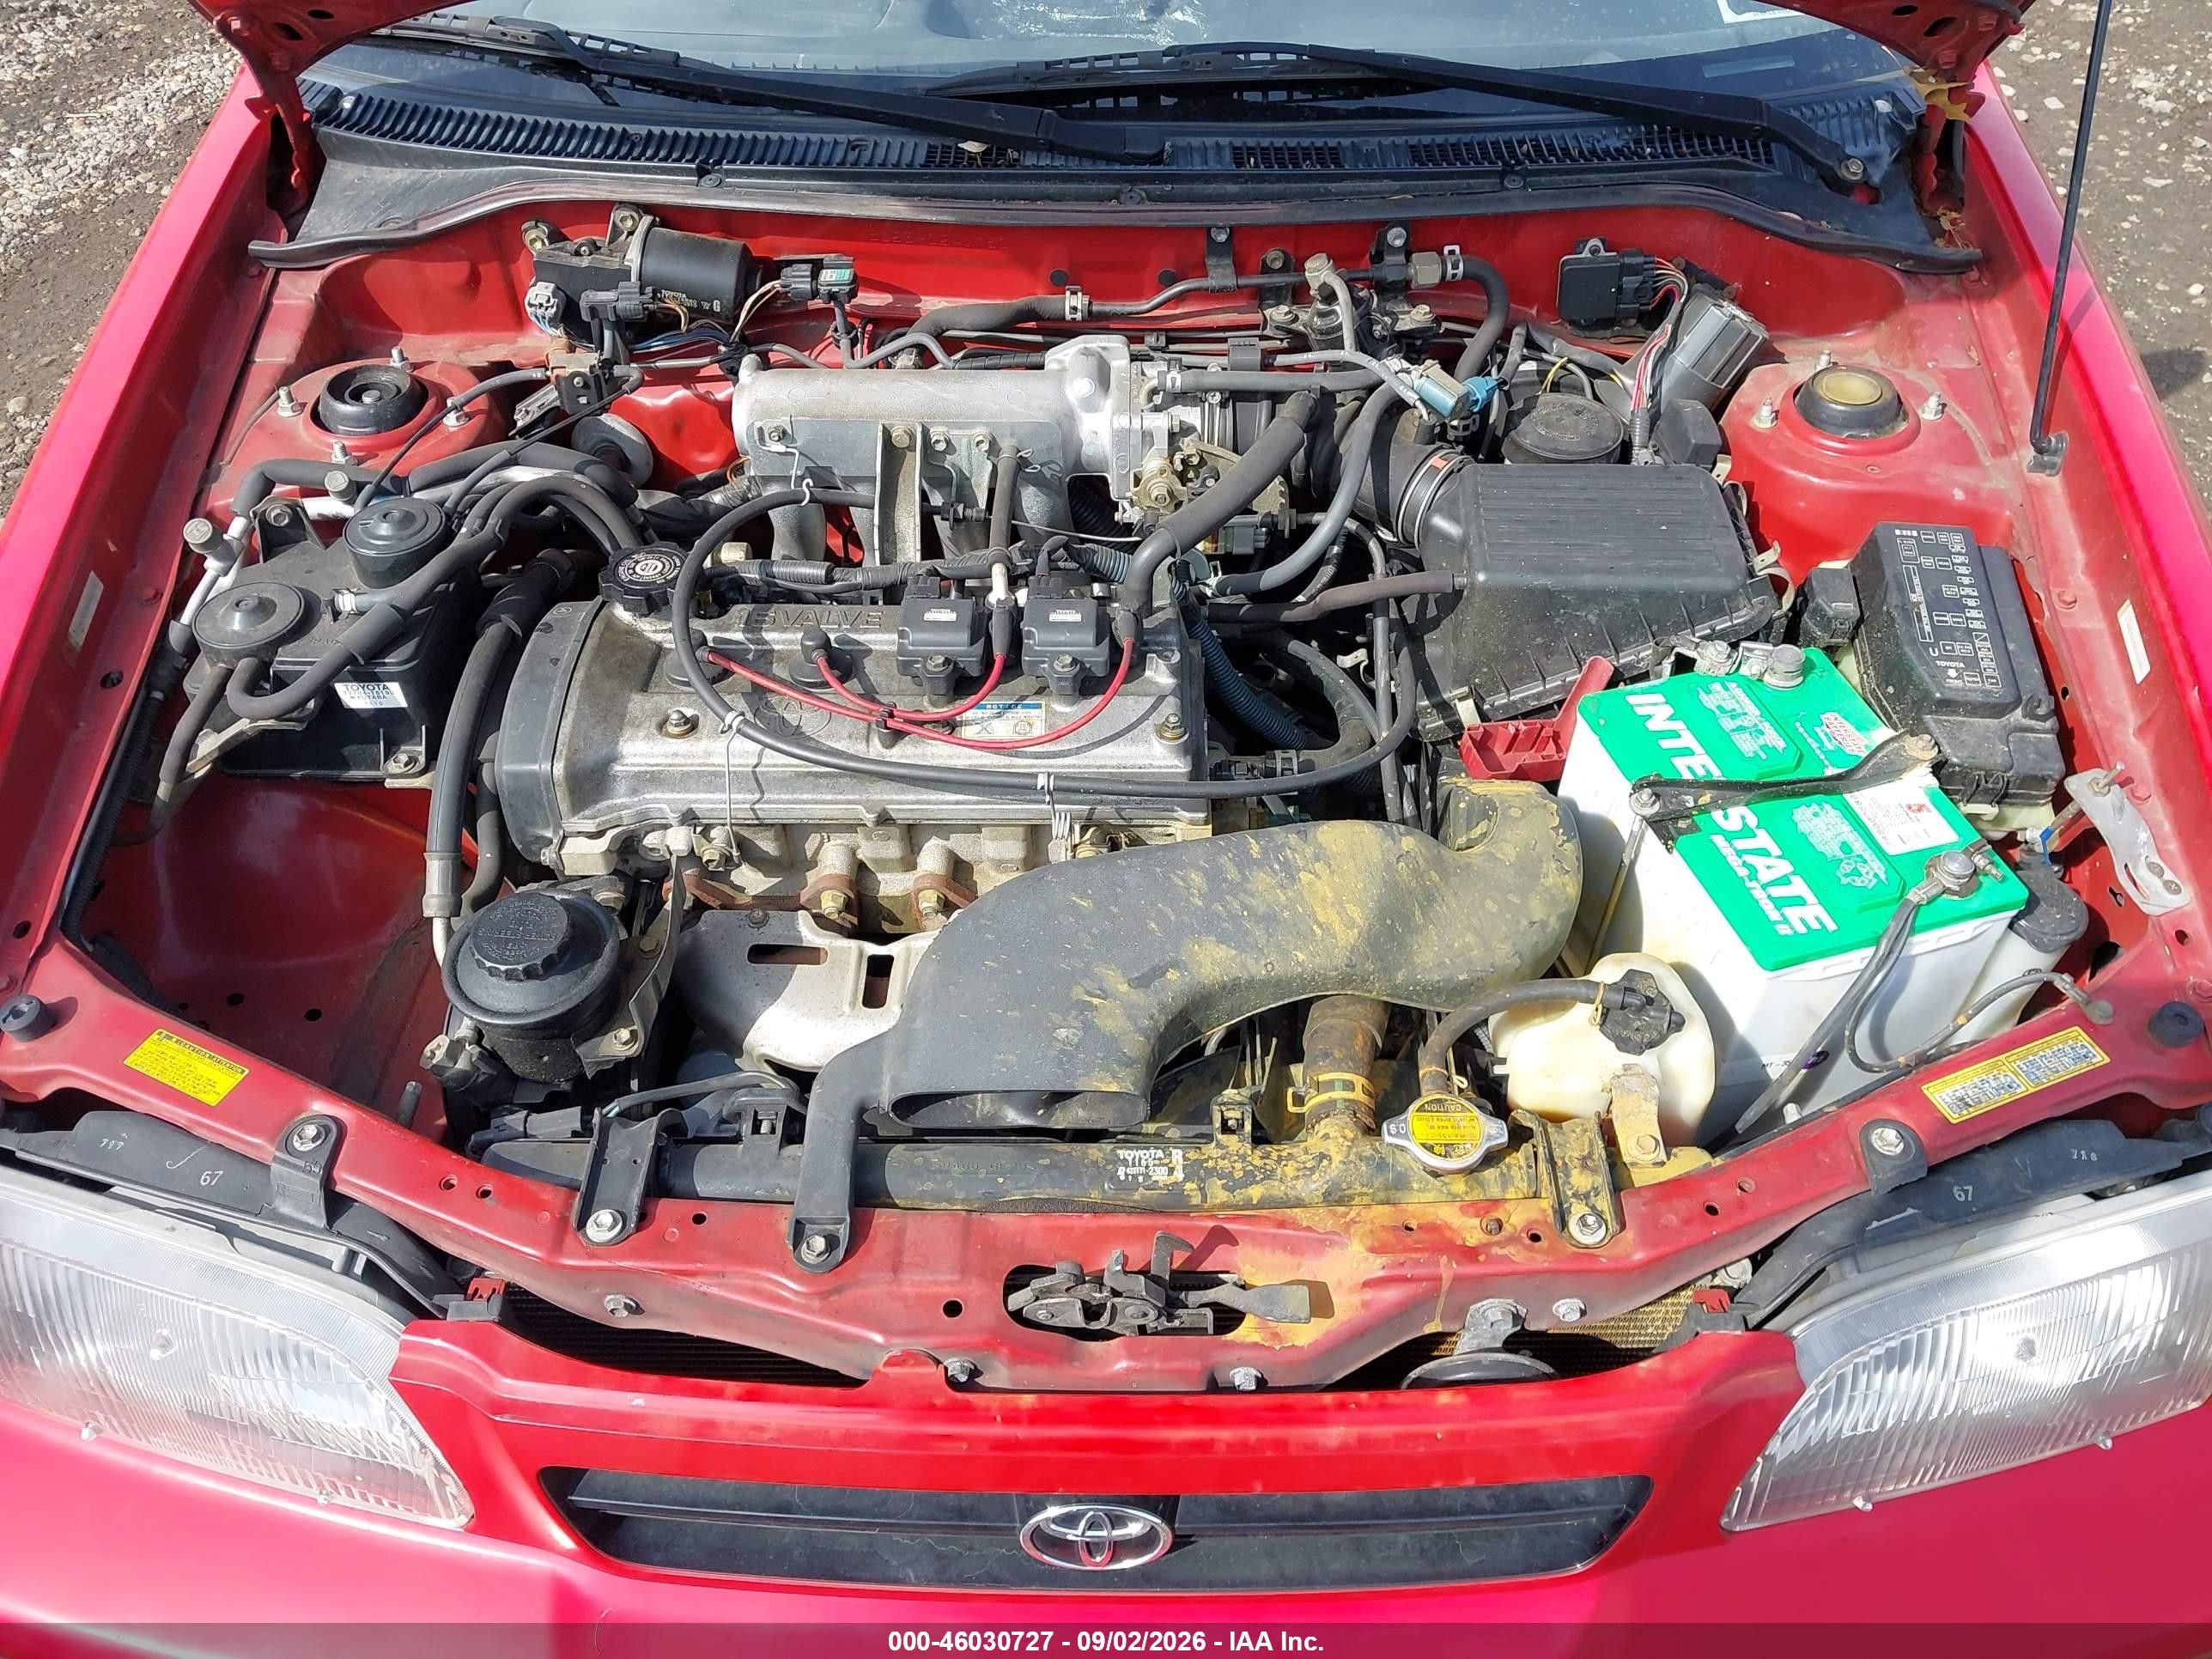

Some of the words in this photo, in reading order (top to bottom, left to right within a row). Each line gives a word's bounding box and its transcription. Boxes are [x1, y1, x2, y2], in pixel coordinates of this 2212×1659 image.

[661, 289, 687, 298] TOYOTA
[713, 300, 721, 313] G
[1935, 659, 1966, 668] TOYOTA
[1117, 1149, 1164, 1160] TOYOTA
[199, 1170, 224, 1187] 67
[1953, 1185, 1973, 1201] 67
